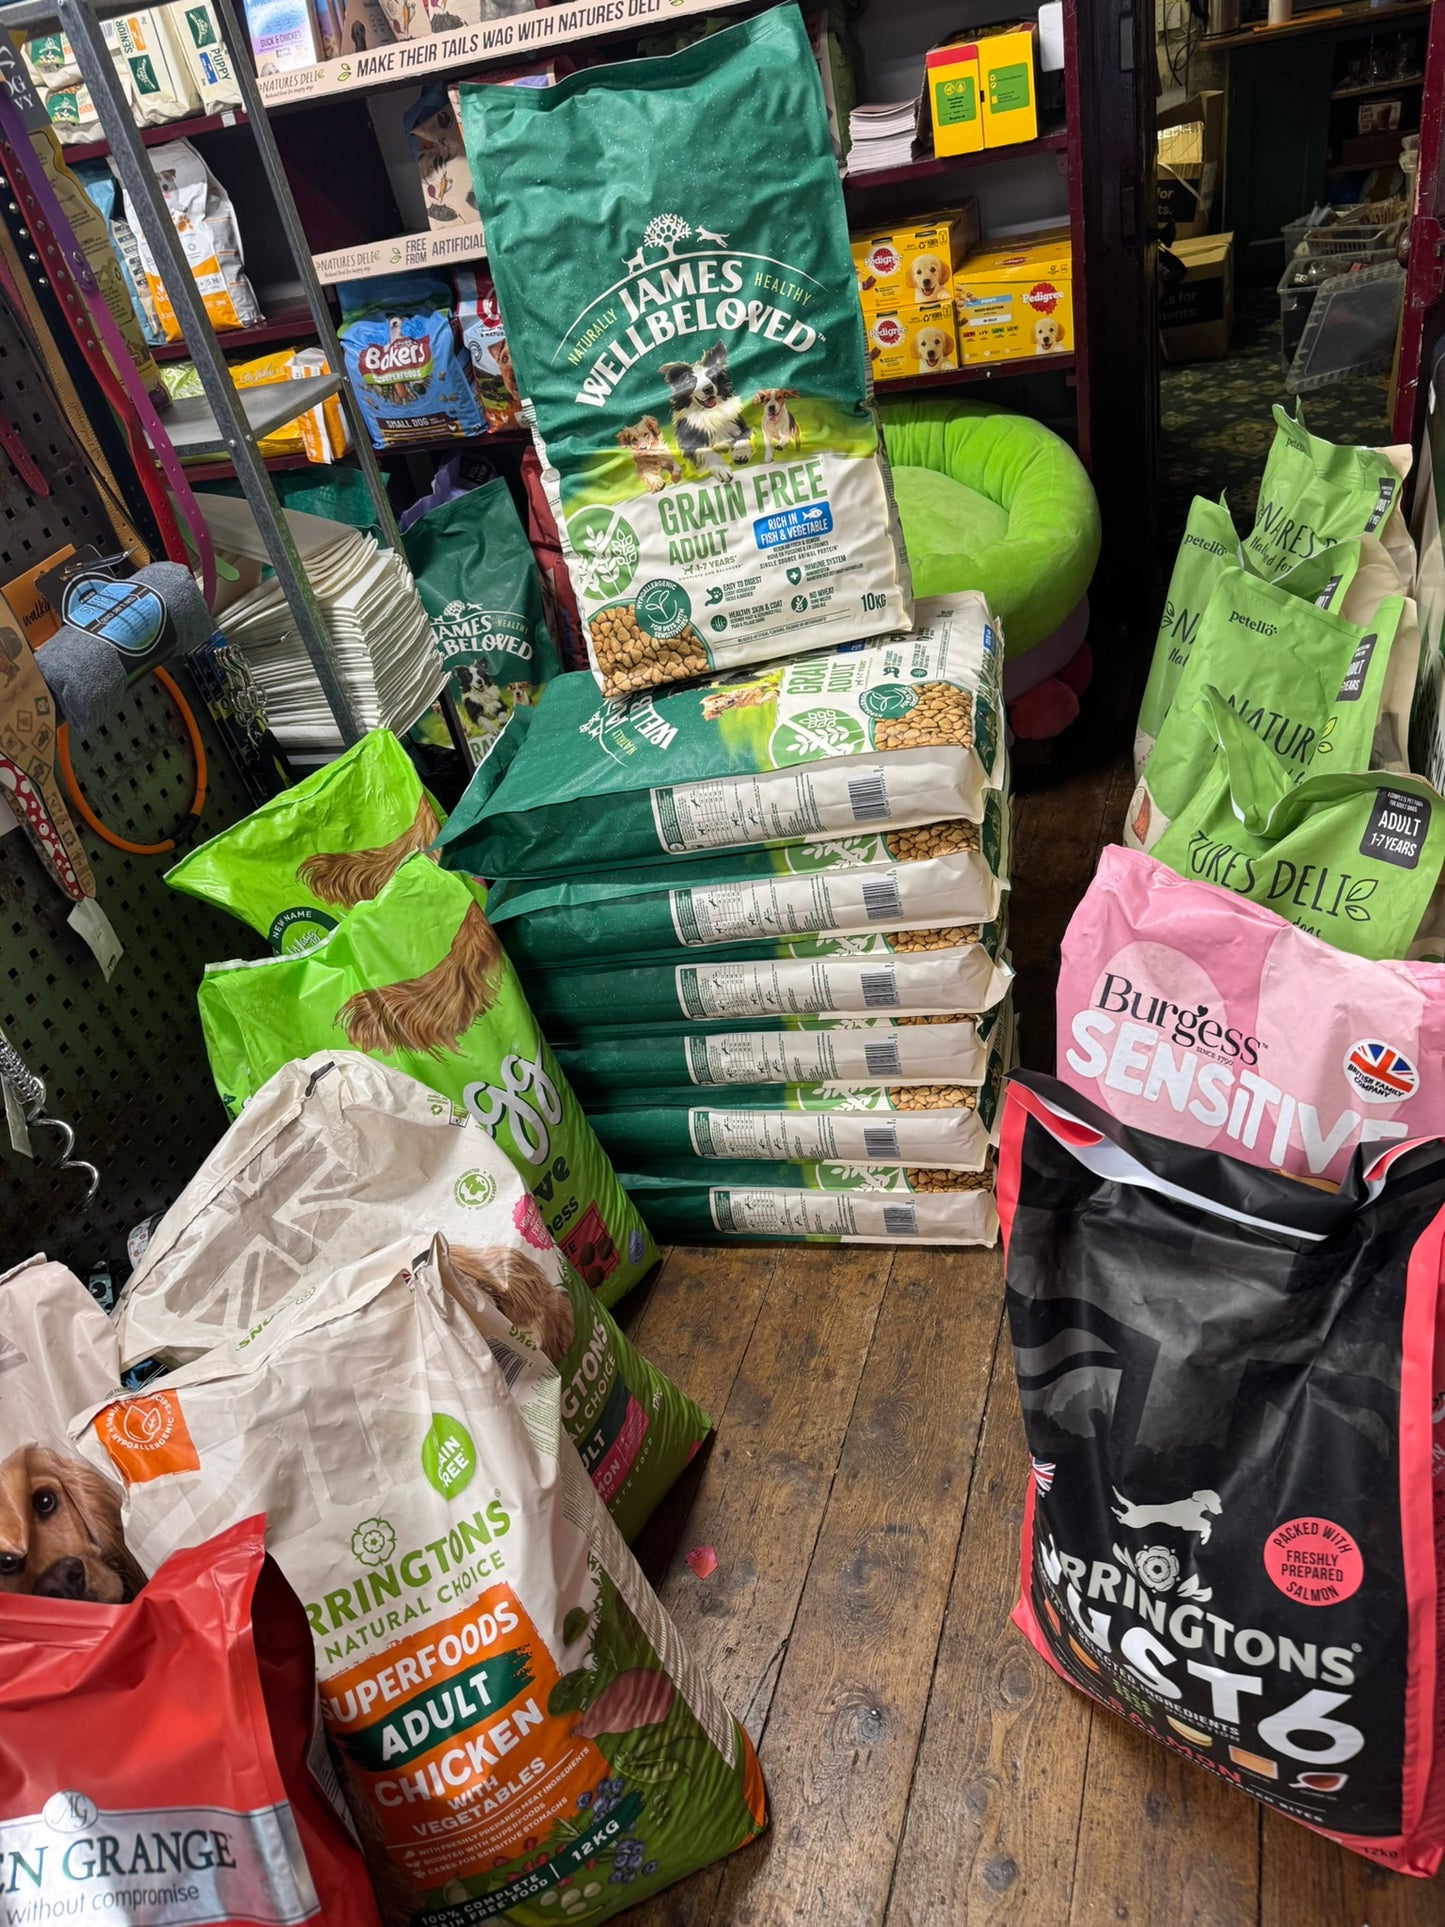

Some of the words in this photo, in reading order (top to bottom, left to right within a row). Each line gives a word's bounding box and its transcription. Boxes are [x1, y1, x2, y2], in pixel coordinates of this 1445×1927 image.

[115, 20, 133, 54] SENIOR
[356, 54, 395, 78] MAKE
[398, 42, 439, 68] THEIR
[441, 33, 480, 59] TAILS
[482, 25, 513, 49] WAG
[517, 16, 555, 41] WITH
[557, 2, 624, 33] NATURES
[627, 0, 664, 18] DELI
[211, 48, 232, 80] PUPPY
[262, 73, 299, 93] NATURES
[405, 238, 427, 253] FREE
[405, 251, 428, 266] FROM
[431, 231, 485, 257] ARTIFICIAL
[863, 252, 902, 268] Pedigree
[319, 256, 357, 272] NATURES
[617, 259, 744, 324] JAMES
[754, 271, 812, 307] HEALTHY
[1021, 287, 1065, 304] Pedigree
[567, 307, 618, 366] NATURALLY
[869, 324, 908, 340] Pedigree
[574, 297, 818, 408] WELLBELOVED
[386, 418, 411, 430] SMALL
[411, 416, 430, 427] DOG
[657, 480, 747, 536] GRAIN
[752, 461, 829, 513] FREE
[761, 531, 779, 546] FISH
[779, 529, 787, 541] &
[788, 518, 829, 540] VEGETABLE
[767, 513, 787, 530] RICH
[788, 512, 798, 527] IN
[668, 527, 729, 567] ADULT
[826, 555, 847, 567] SYSTEM
[636, 580, 678, 610] HYPOALLERGENIC
[722, 583, 737, 592] EASY
[429, 615, 493, 645] JAMES
[650, 623, 663, 633] FOR
[662, 619, 677, 632] PETS
[676, 608, 685, 625] WITH
[653, 617, 690, 639] SENSITIVITIES
[1378, 809, 1422, 837] ADULT
[1371, 832, 1385, 847] 1-7
[1384, 836, 1417, 857] YEARS
[1267, 859, 1352, 918] DELI
[273, 918, 286, 940] NEW
[283, 910, 312, 923] NAME
[1095, 972, 1262, 1066] Burgess
[1195, 1045, 1216, 1061] SINCE
[1216, 1054, 1235, 1067] 1790
[1347, 1063, 1375, 1085] BRITISH
[1375, 1081, 1405, 1097] FAMILY
[1353, 1076, 1391, 1098] COMPANY
[561, 1315, 609, 1420] GTONS
[584, 1354, 617, 1420] CHOICE
[111, 1417, 175, 1451] HYPOALLERGENIC
[1272, 1521, 1319, 1549] PACKED
[1322, 1525, 1353, 1554] WITH
[1281, 1563, 1344, 1583] PREPARED
[1286, 1549, 1340, 1567] FRESHLY
[324, 1596, 432, 1664] NATURAL
[436, 1550, 506, 1604] CHOICE
[1285, 1580, 1340, 1602] SALMON
[320, 1601, 519, 1724] SUPERFOODS
[381, 1670, 493, 1762] ADULT
[1138, 1680, 1241, 1738] INGREDIENTS
[1107, 1695, 1242, 1785] SALMON
[1256, 1688, 1366, 1766] 6
[374, 1697, 544, 1808] CHICKEN
[412, 1756, 547, 1838] VEGETABLES
[418, 1844, 441, 1856] WITH
[441, 1832, 478, 1853] FRESHLY
[478, 1808, 522, 1839] PREPARED
[521, 1791, 545, 1811] MEAT
[543, 1747, 590, 1793] INGREDIENTS
[447, 1774, 499, 1811] WITH
[423, 1850, 465, 1866] BOOSTED
[465, 1839, 489, 1854] WITH
[489, 1802, 547, 1843] SUPERFOODS
[427, 1862, 459, 1875] CARES
[458, 1854, 477, 1866] FOR
[477, 1831, 524, 1862] SENSITIVE
[523, 1797, 569, 1833] STOMACHS
[570, 1819, 621, 1863] 12KG
[62, 1829, 237, 1881] GRANGE
[7, 1899, 85, 1926] without
[91, 1882, 200, 1912] compromise
[464, 1873, 540, 1915] COMPLETE
[469, 1901, 505, 1922] FREE
[511, 1878, 549, 1903] FOOD
